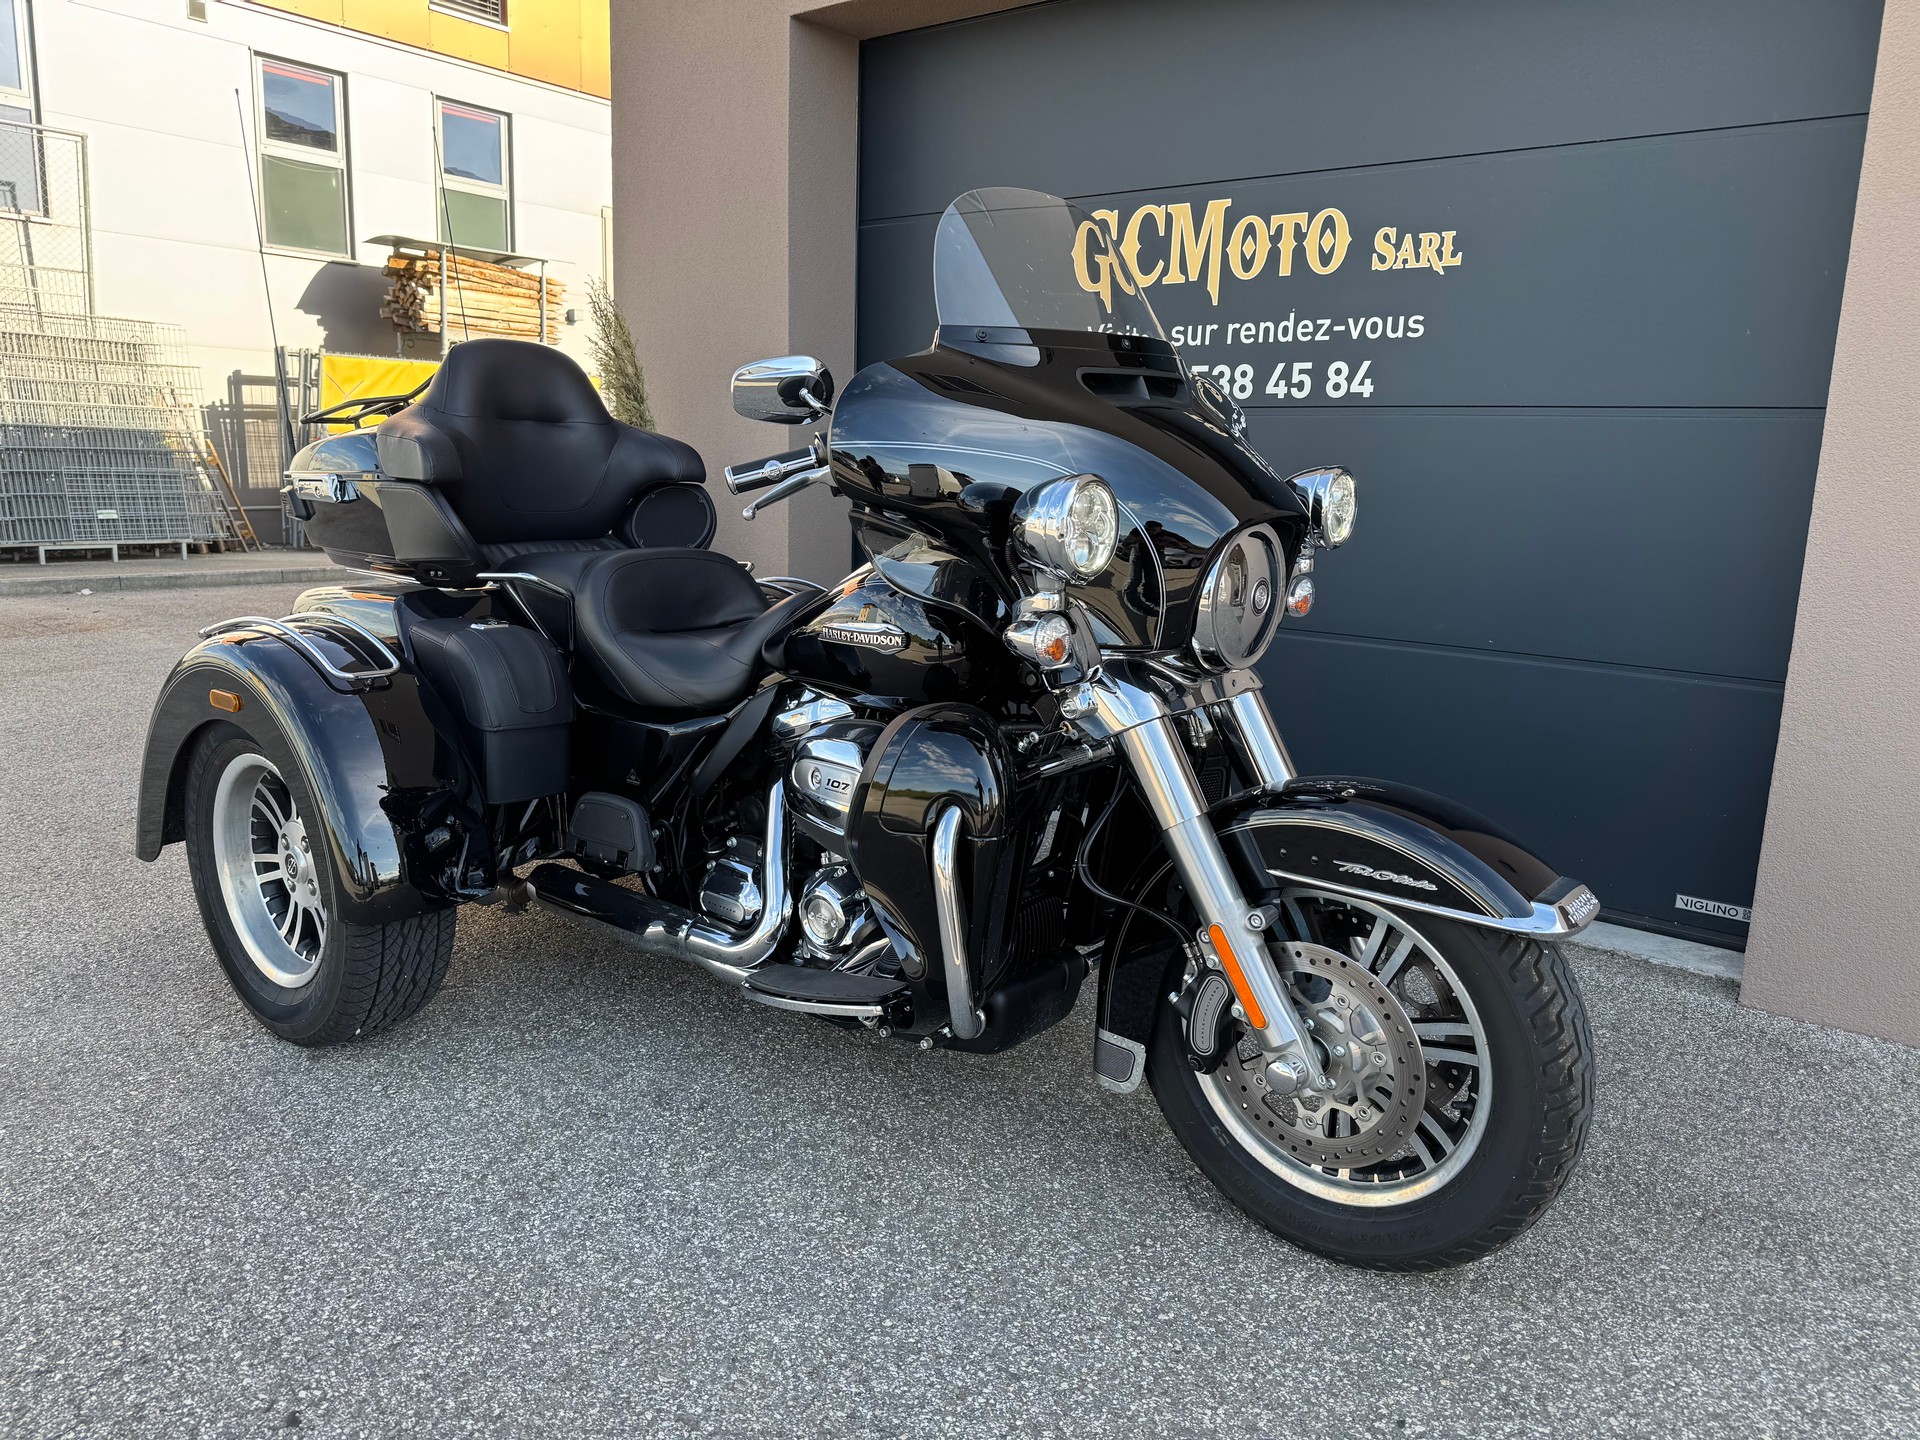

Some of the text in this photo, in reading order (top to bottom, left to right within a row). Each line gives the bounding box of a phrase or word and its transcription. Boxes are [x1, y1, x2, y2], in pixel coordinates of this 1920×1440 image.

[1171, 322, 1219, 347] sur
[1226, 308, 1426, 345] rendez-vous
[1191, 359, 1375, 400] 38 45 84
[821, 627, 903, 646] HARLEY-DAVIDSON
[825, 777, 851, 792] 107
[1679, 896, 1739, 918] VIGLINO
